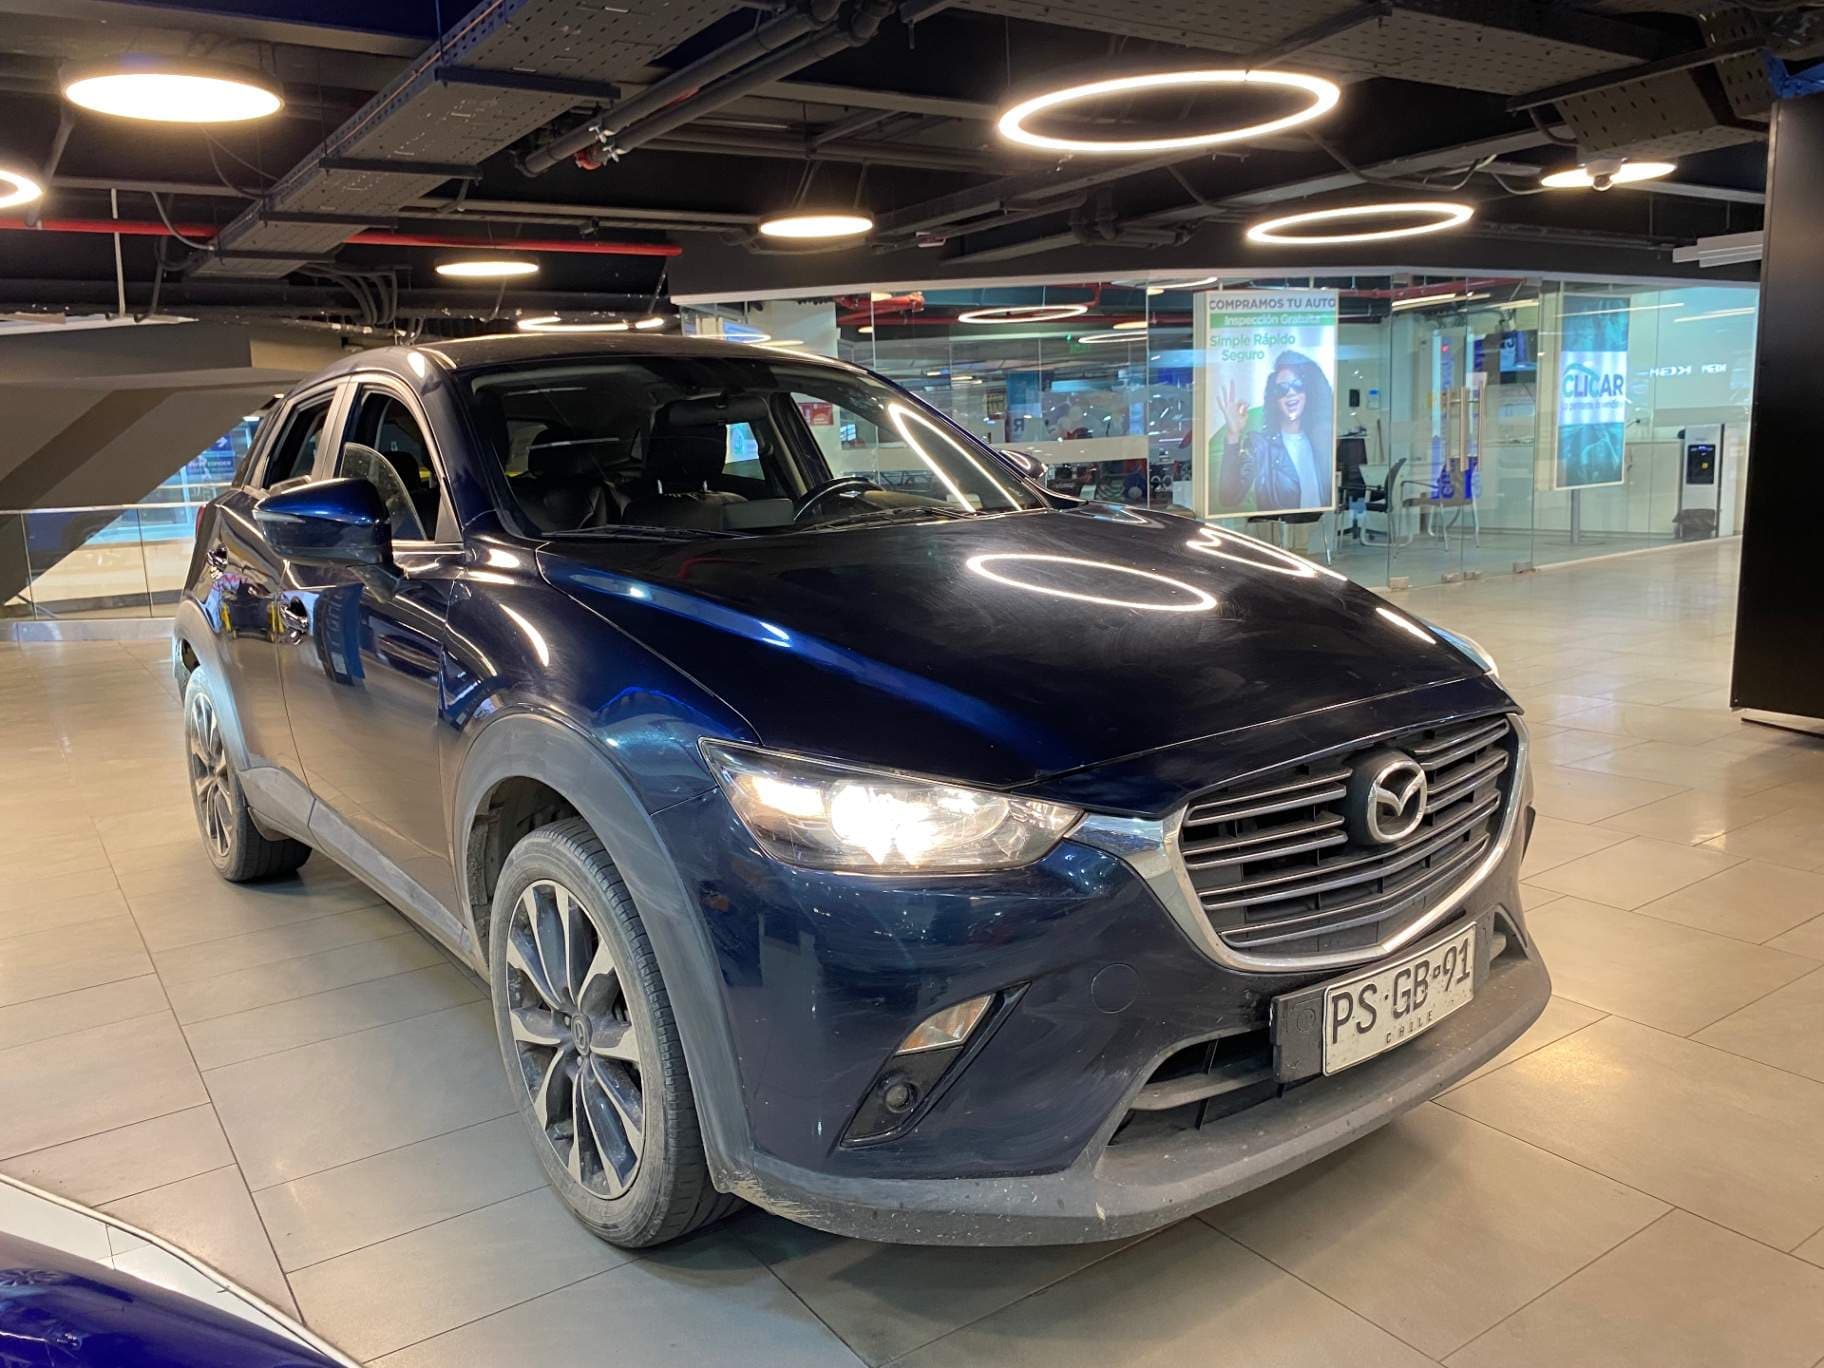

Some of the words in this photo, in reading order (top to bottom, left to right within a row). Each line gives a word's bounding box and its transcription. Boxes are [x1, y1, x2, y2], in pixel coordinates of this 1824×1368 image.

[1209, 299, 1284, 310] COMPRAMOS
[1288, 298, 1302, 308] TU
[1305, 298, 1336, 308] AUTO
[1209, 335, 1250, 348] Simple
[1253, 332, 1296, 347] Rápido
[1222, 349, 1265, 362] Seguro
[1563, 374, 1624, 398] CLICAR
[1386, 1009, 1433, 1044] CHILE
